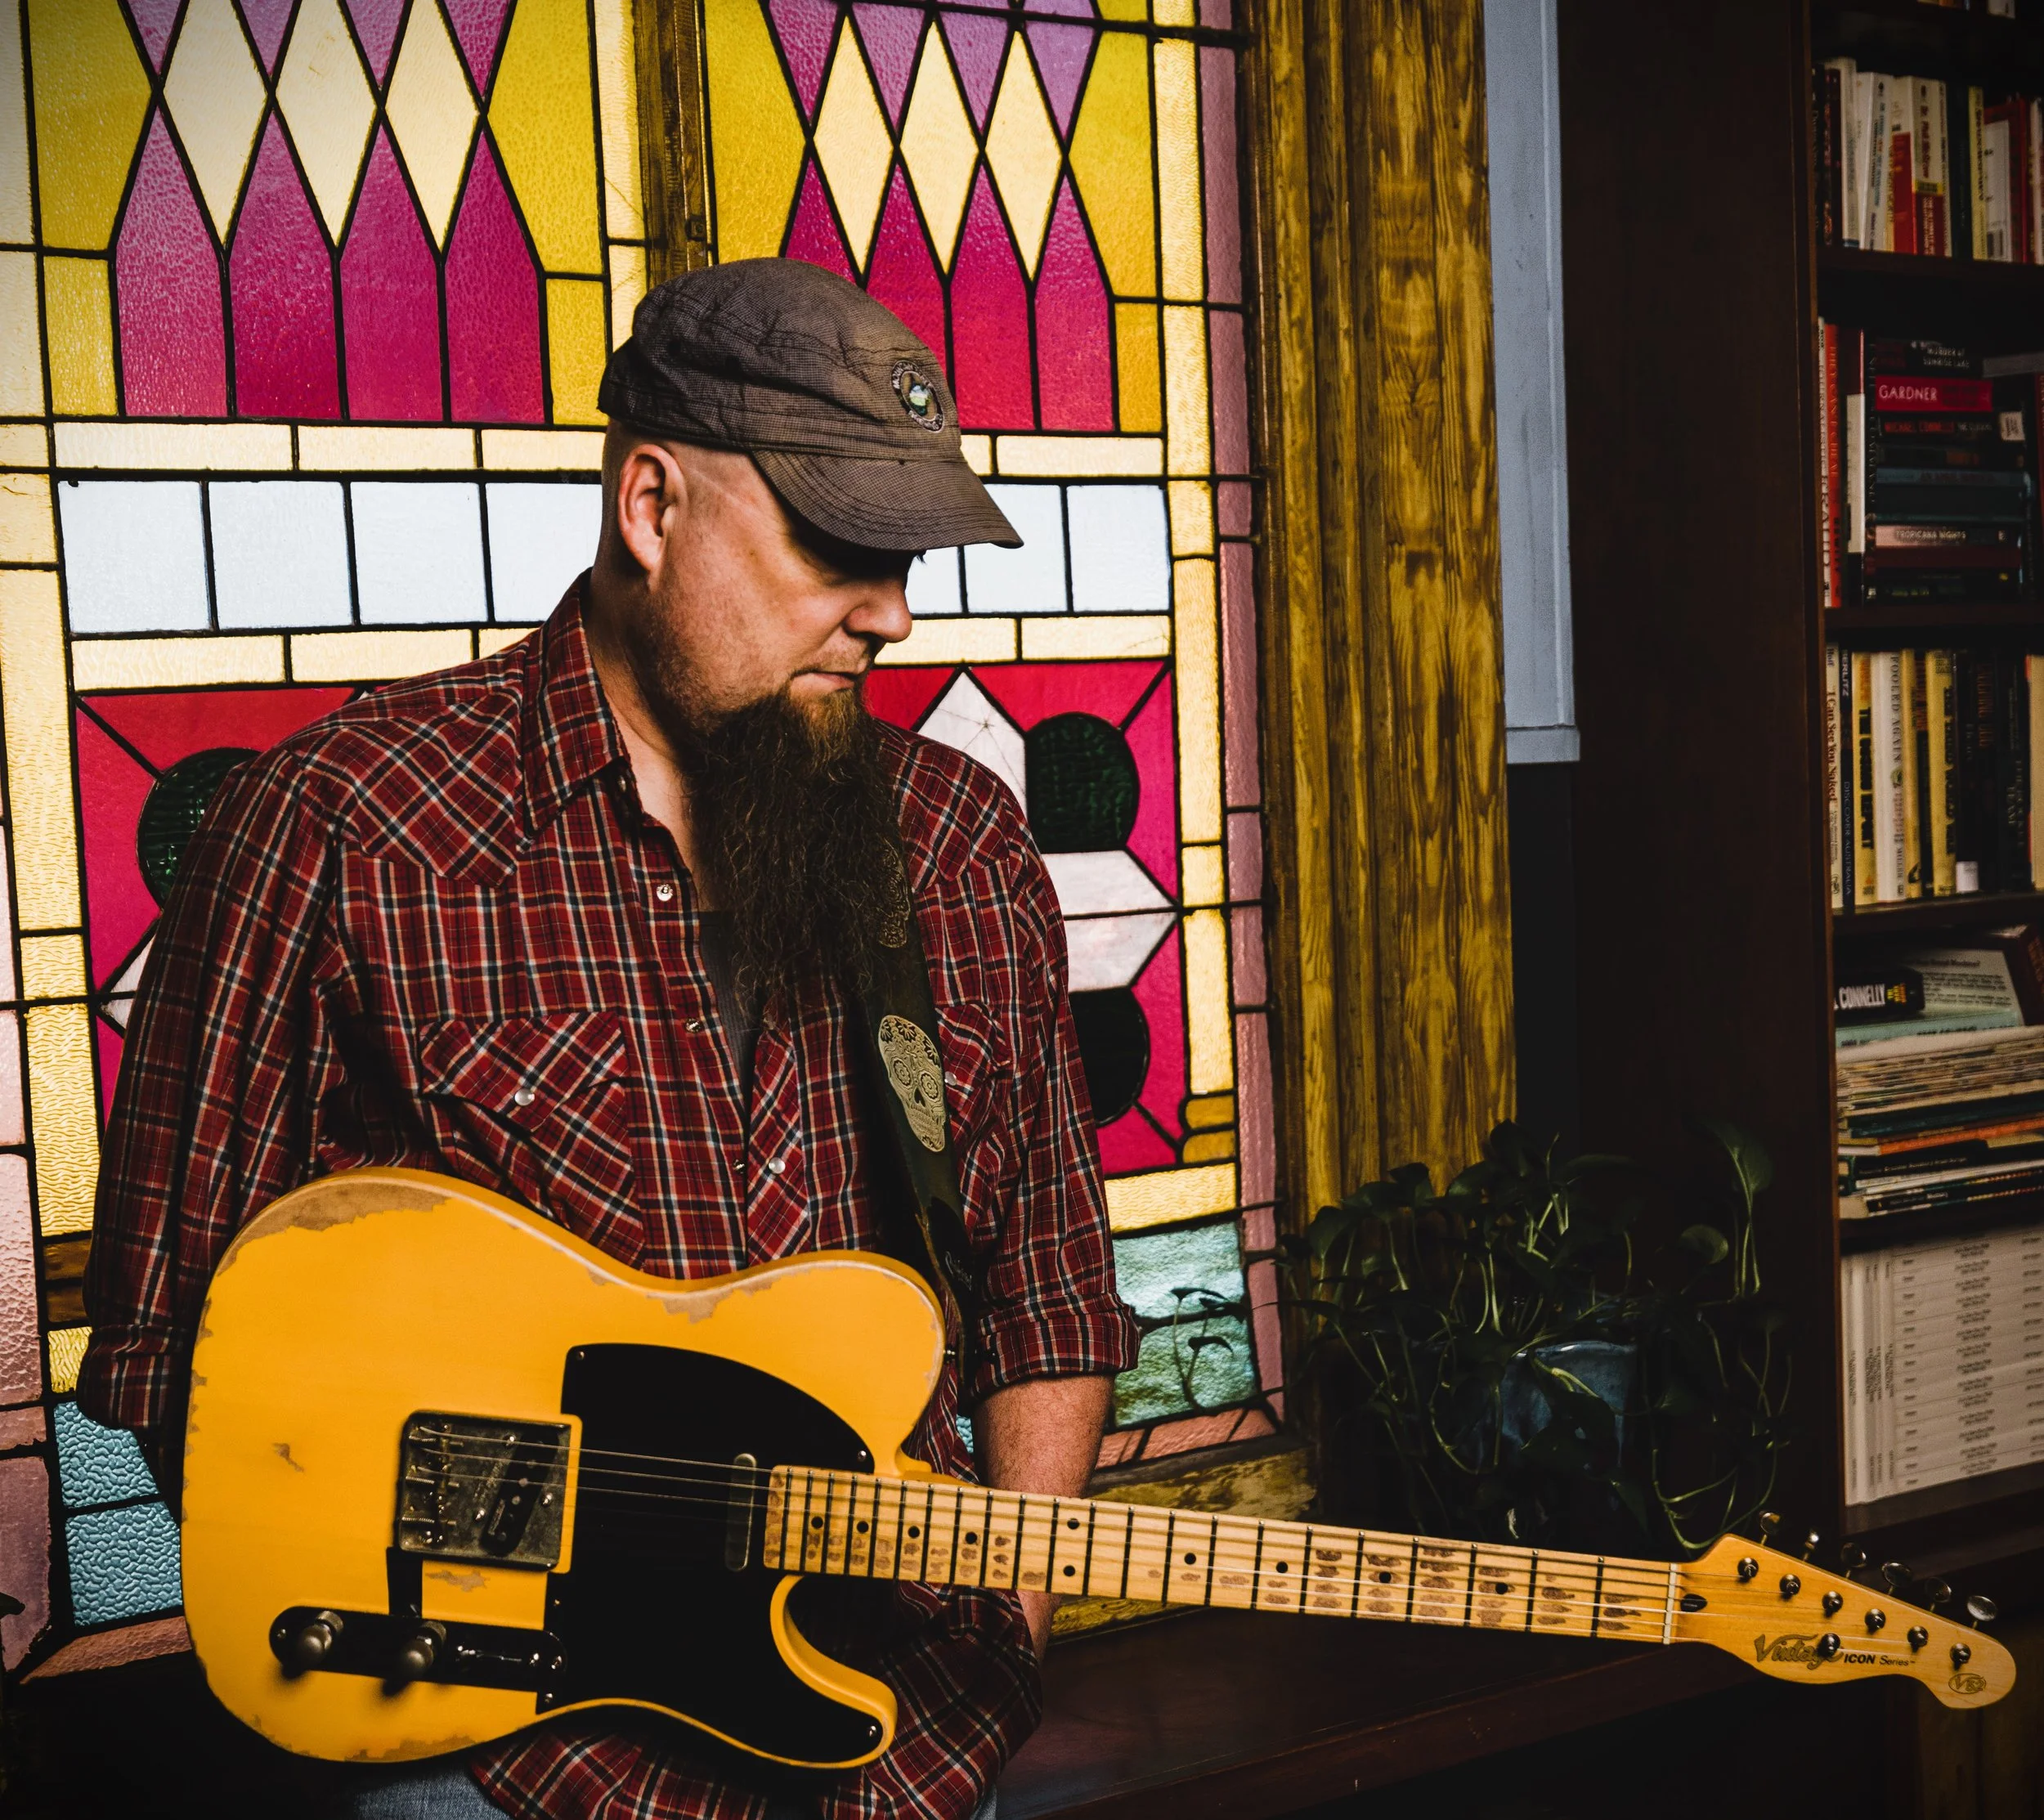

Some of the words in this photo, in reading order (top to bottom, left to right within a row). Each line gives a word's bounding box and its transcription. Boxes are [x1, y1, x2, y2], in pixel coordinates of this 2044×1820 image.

[1878, 384, 1938, 402] GARDNER
[1895, 530, 1937, 540] TROPICANA
[1890, 656, 1901, 712] FOOLED
[1827, 698, 1837, 721] Can
[1827, 723, 1837, 742] See
[1892, 716, 1903, 762] AGAIN
[1844, 781, 1852, 836] DISCOVER
[1838, 983, 1886, 1011] CONNELLY
[1844, 1653, 1876, 1665] ICON
